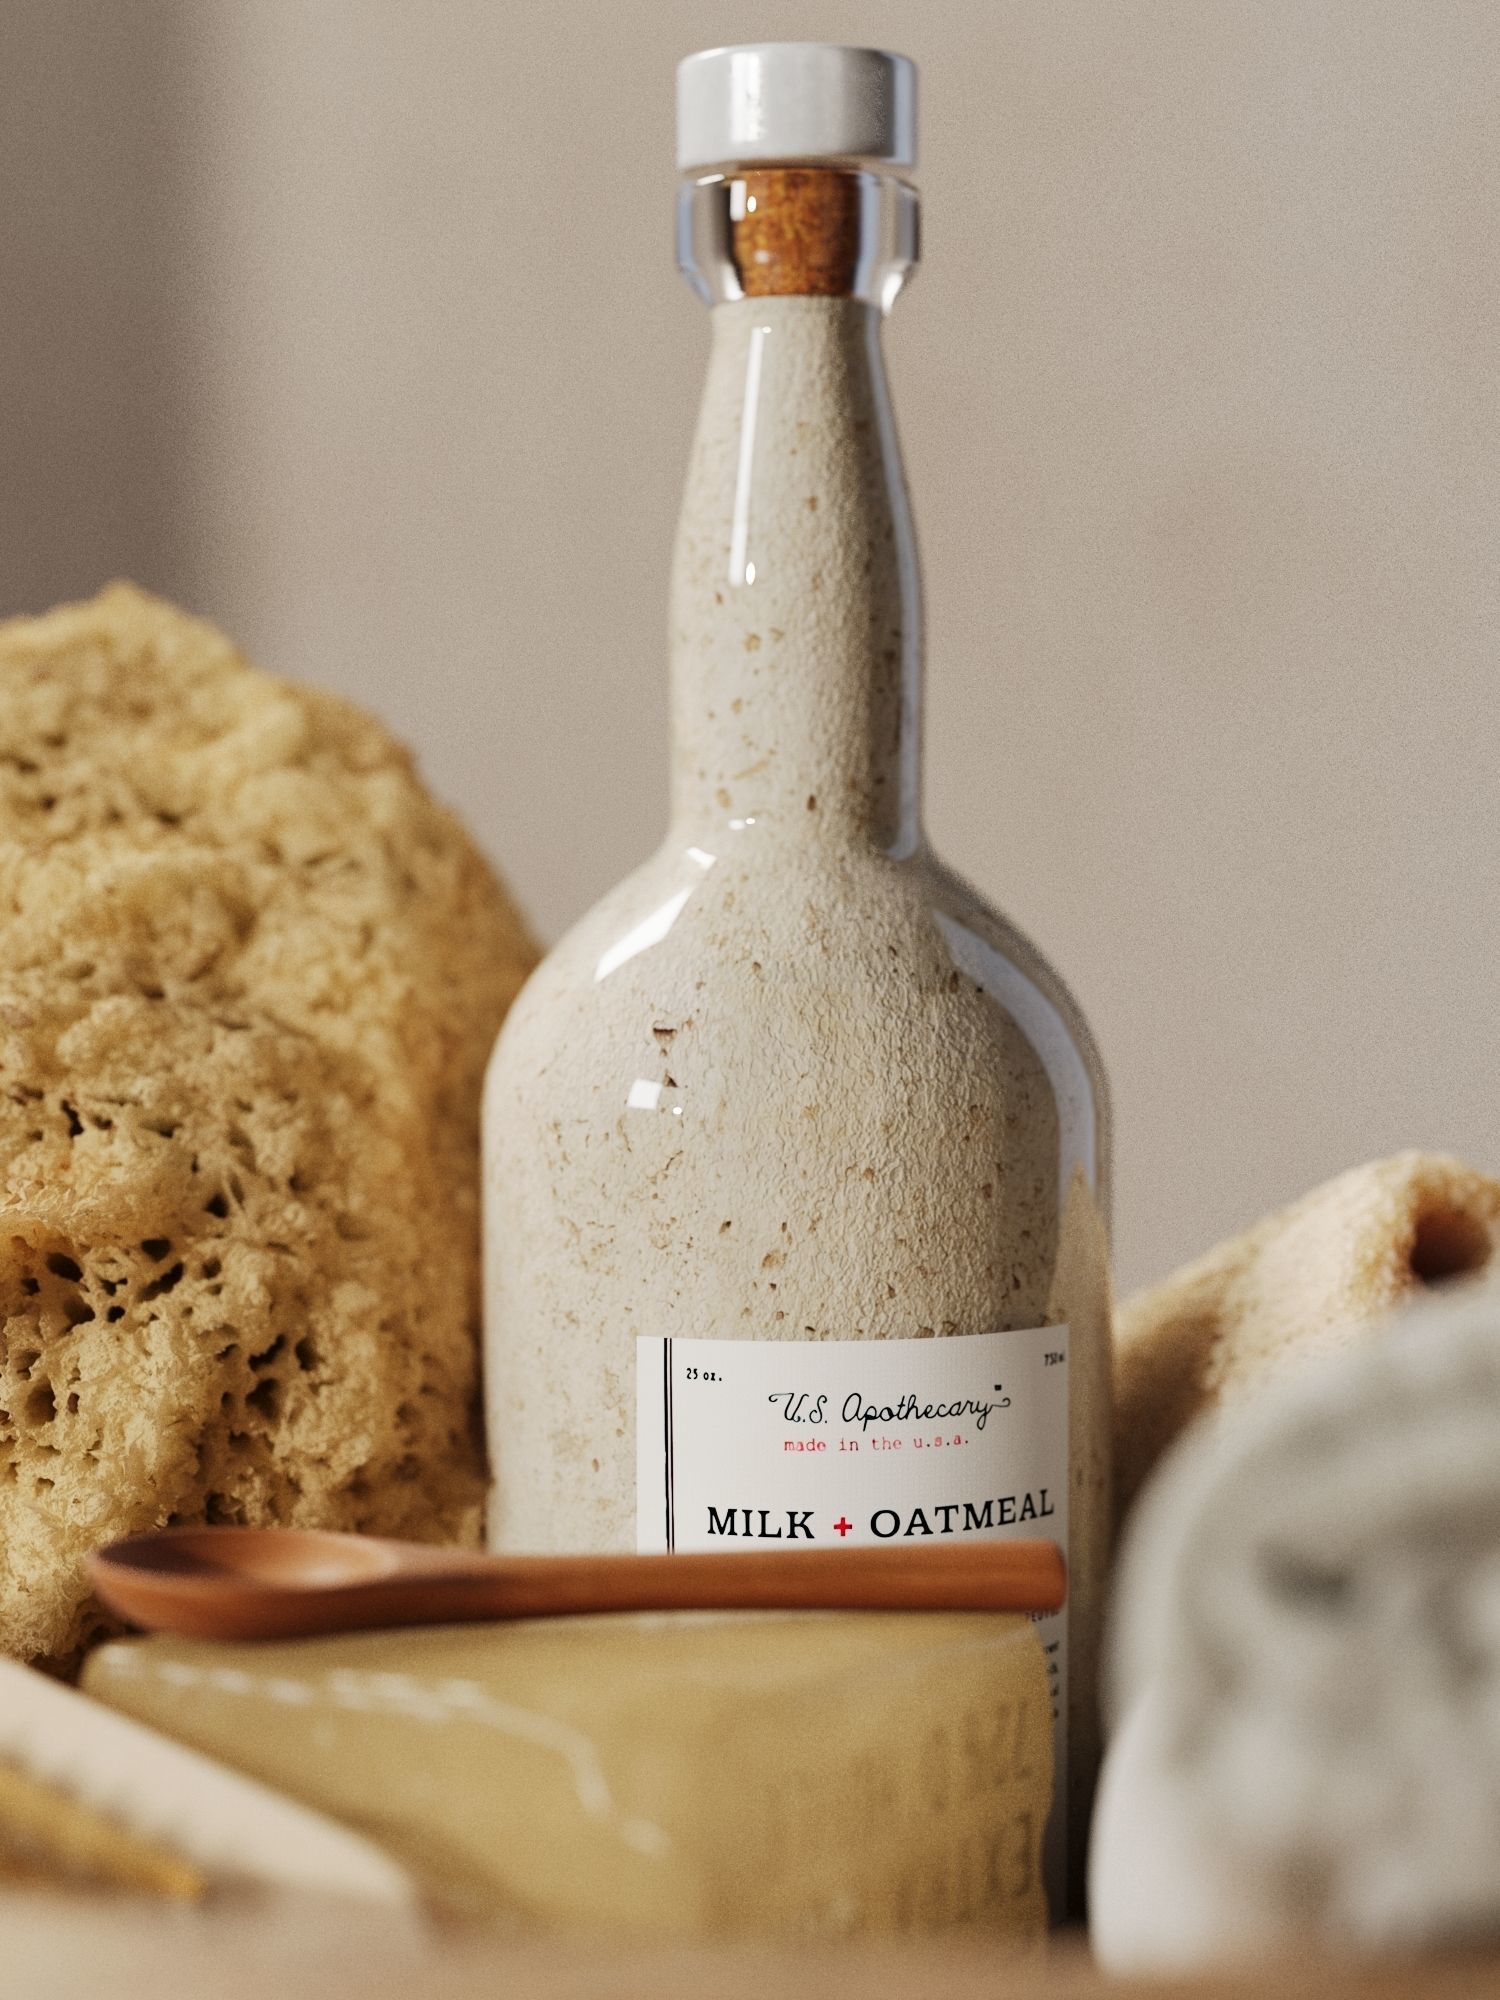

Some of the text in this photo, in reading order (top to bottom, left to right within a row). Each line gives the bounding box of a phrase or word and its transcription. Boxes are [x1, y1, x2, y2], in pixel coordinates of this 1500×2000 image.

[686, 1367, 722, 1382] 25 oz.
[768, 1392, 1011, 1432] U.S. Apothecary
[783, 1433, 969, 1452] made in the u.s.a.
[707, 1506, 815, 1539] MILK
[870, 1489, 1055, 1538] OATMEAL
